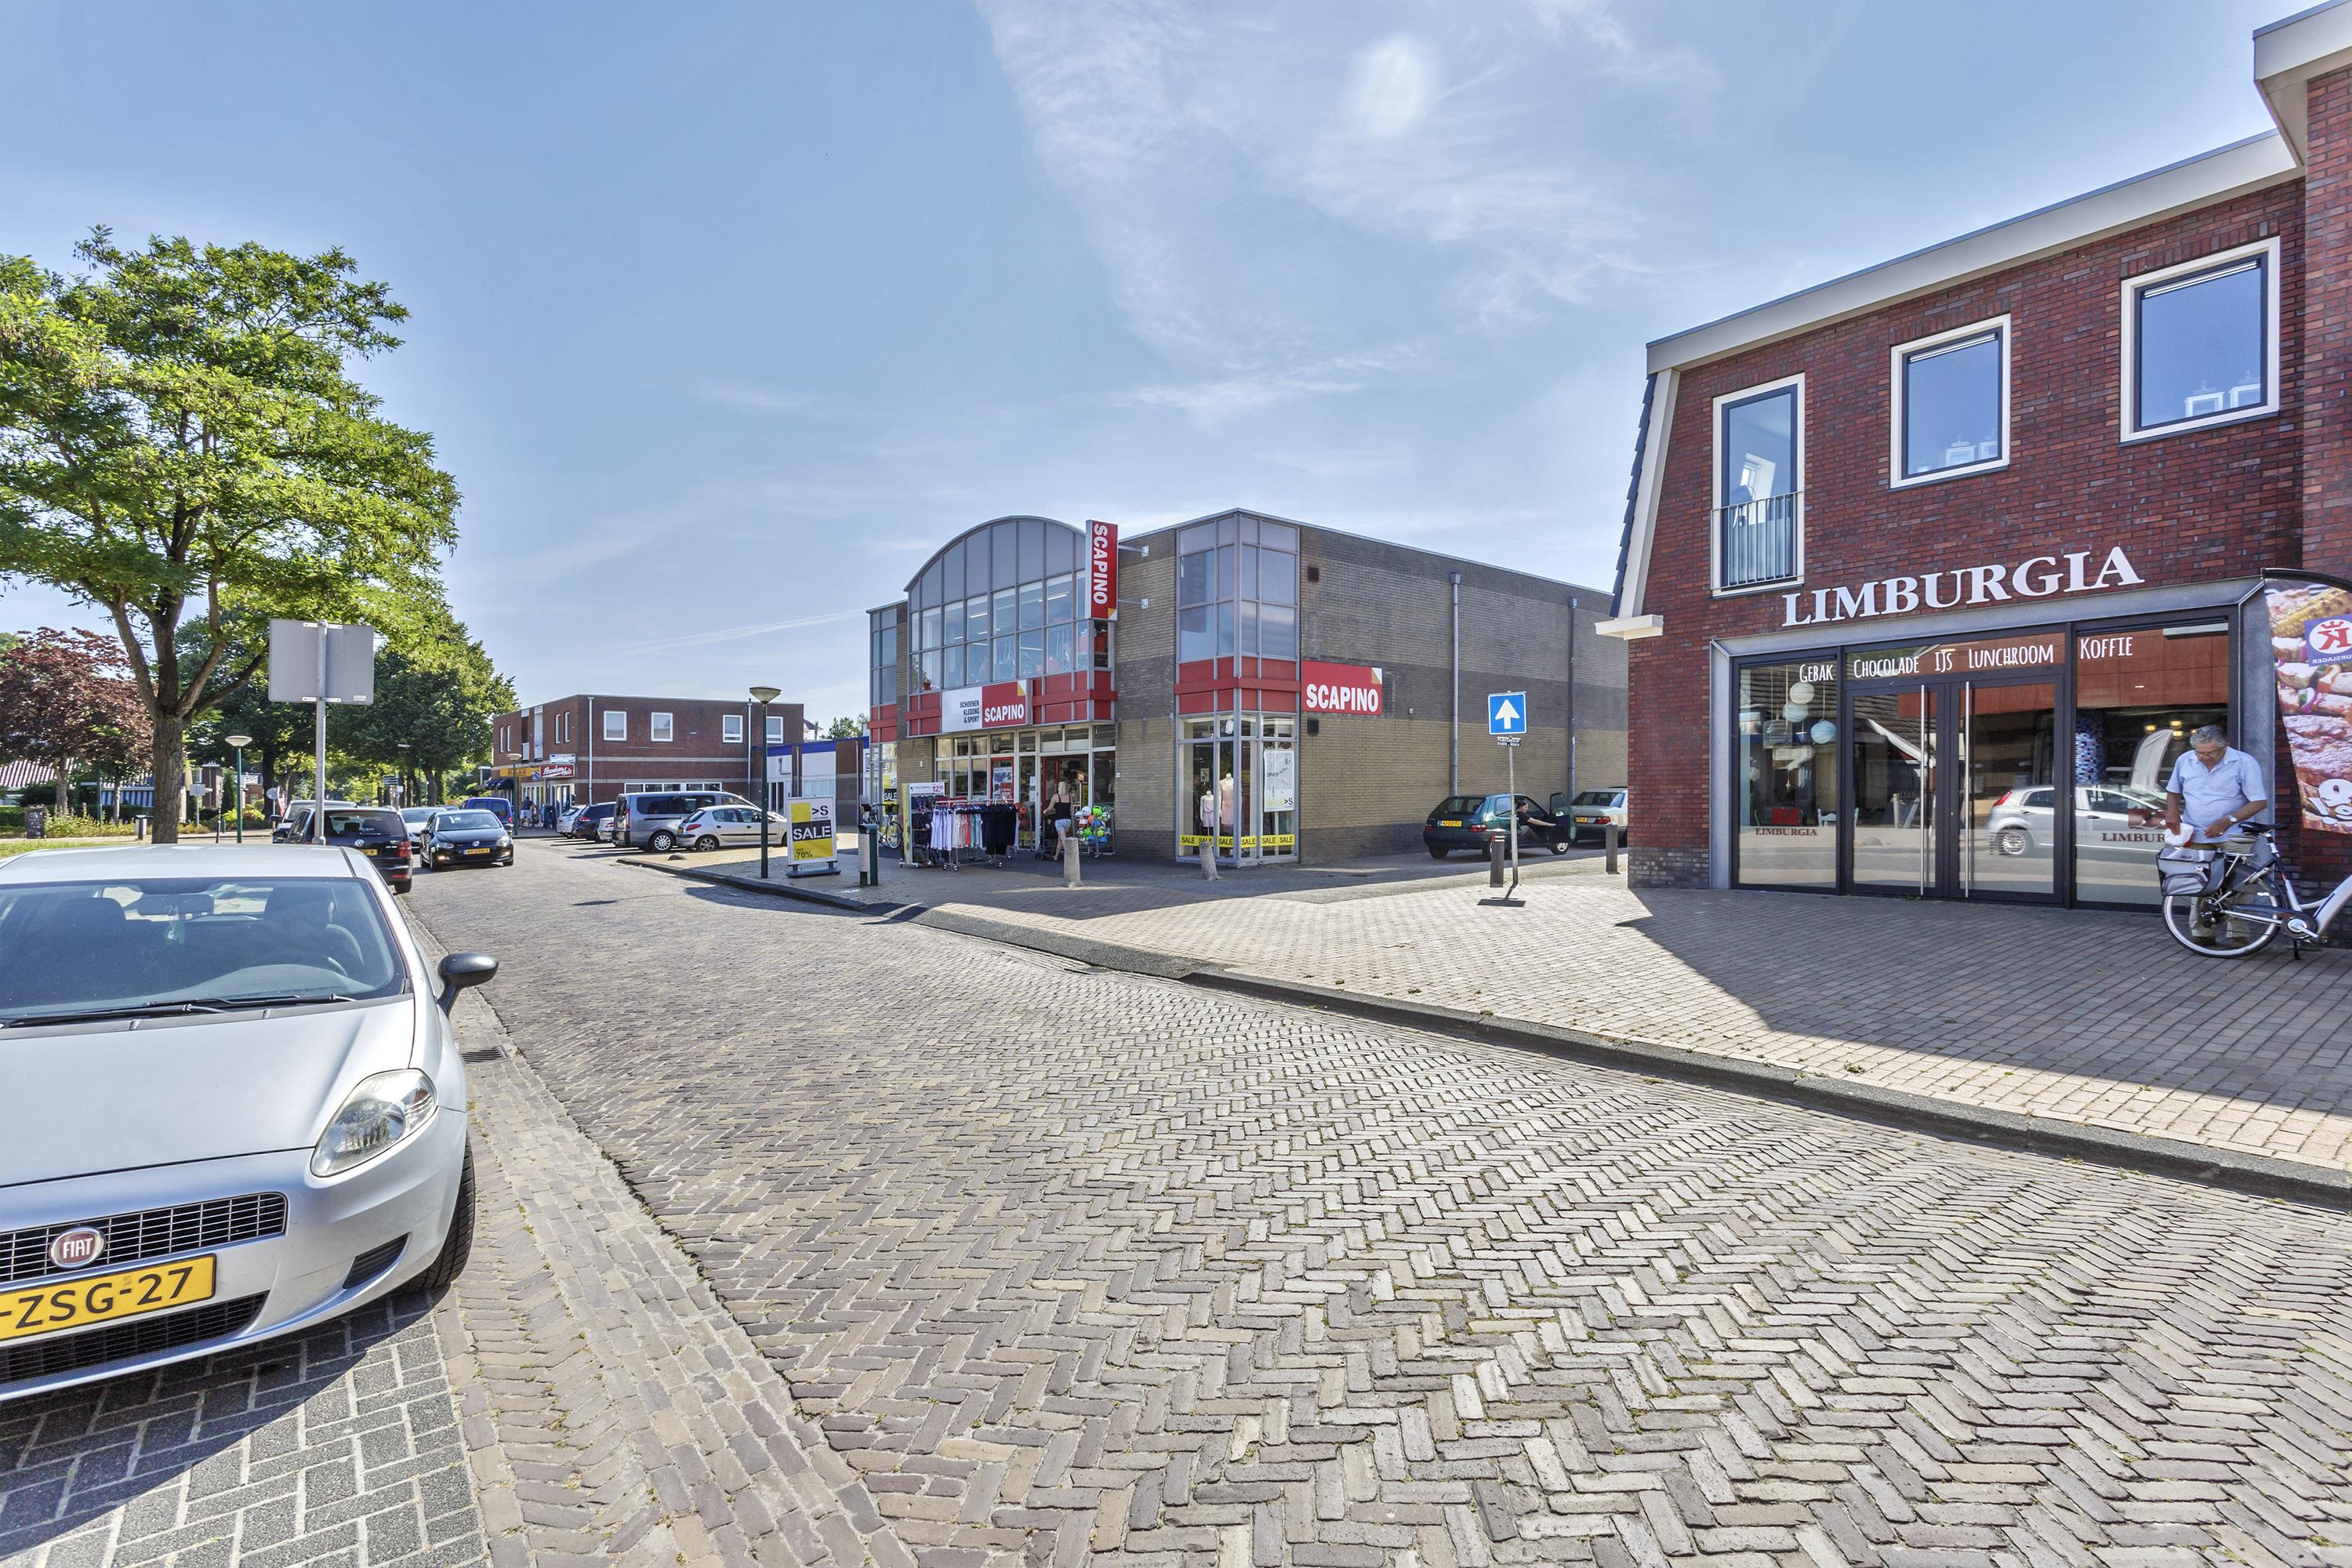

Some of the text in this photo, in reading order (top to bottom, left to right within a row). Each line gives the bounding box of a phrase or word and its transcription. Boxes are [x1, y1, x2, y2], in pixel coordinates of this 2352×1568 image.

[1094, 524, 1108, 604] SCAPINO
[1781, 546, 2145, 626] LIMBURGIA
[1306, 684, 1379, 712] SCAPINO
[984, 703, 1025, 722] SCAPINO
[793, 826, 831, 840] SALE
[63, 1238, 93, 1258] FIAT
